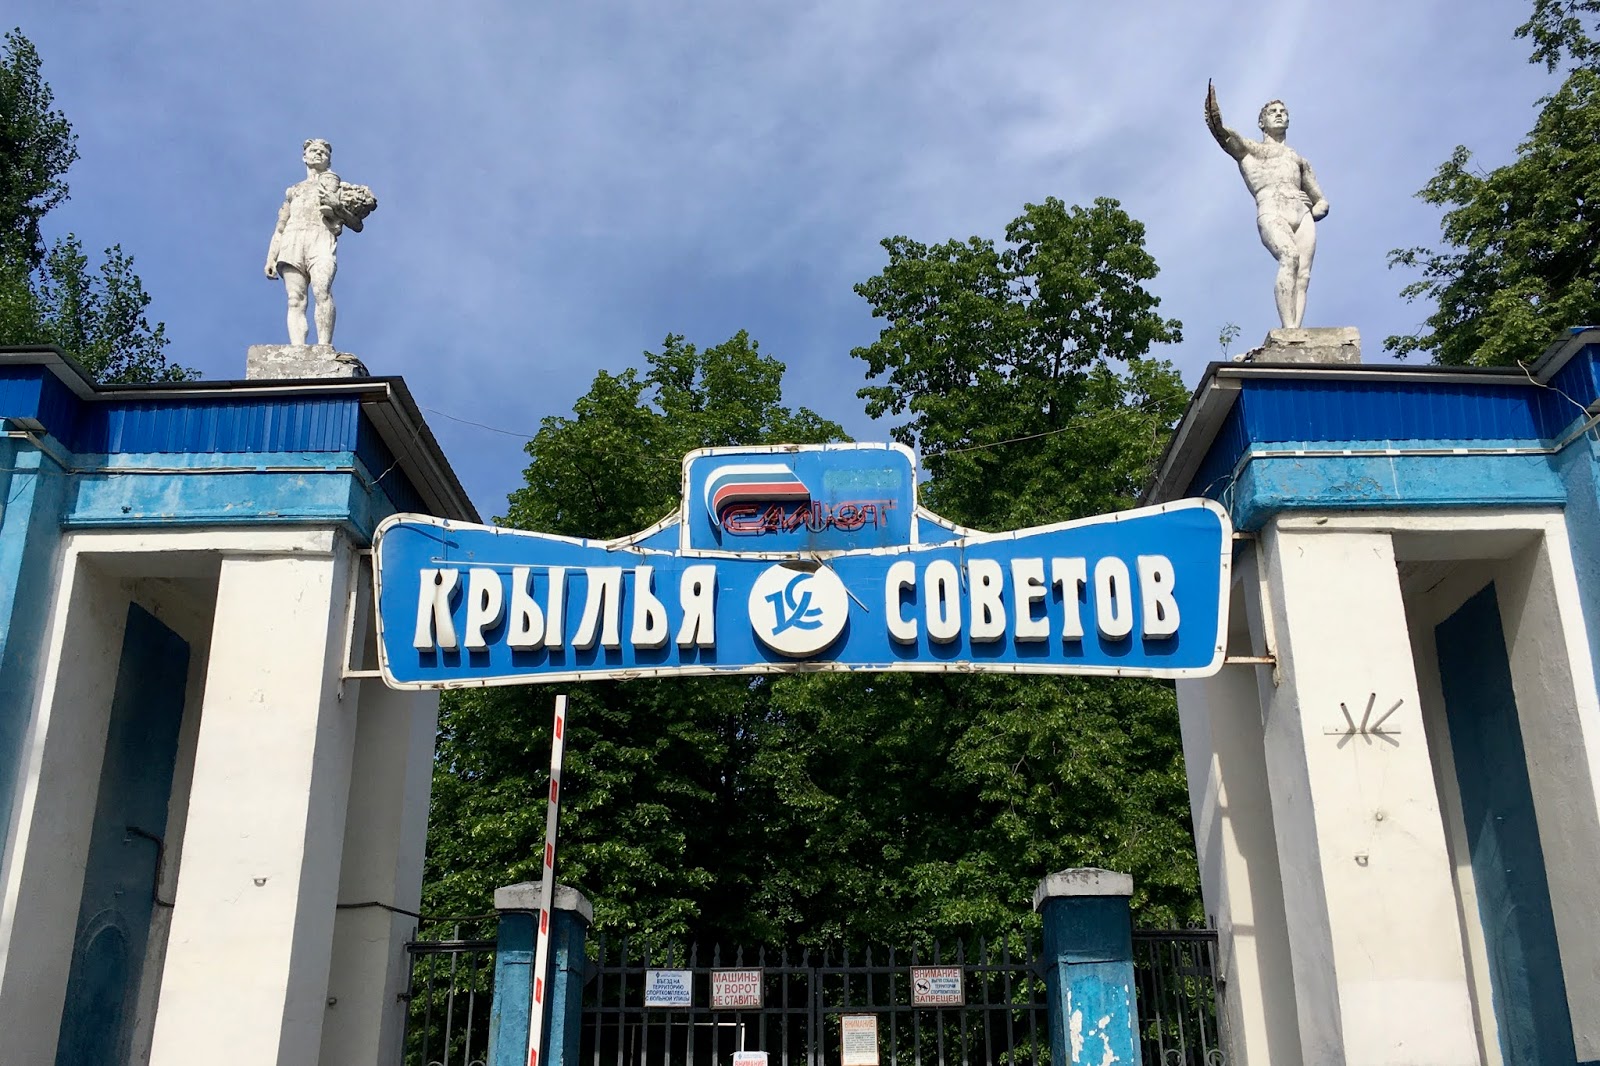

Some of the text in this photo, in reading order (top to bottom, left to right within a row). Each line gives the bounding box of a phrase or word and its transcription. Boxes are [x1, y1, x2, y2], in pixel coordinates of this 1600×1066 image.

[413, 555, 1181, 651] КРЫЛЬЯ СОВЕТОВ
[713, 972, 760, 983] МАШИНЫ
[716, 984, 757, 994] У ВОРОТ
[713, 995, 723, 1006] НЕ
[915, 995, 961, 1003] ЗАПРЕЩЕН!
